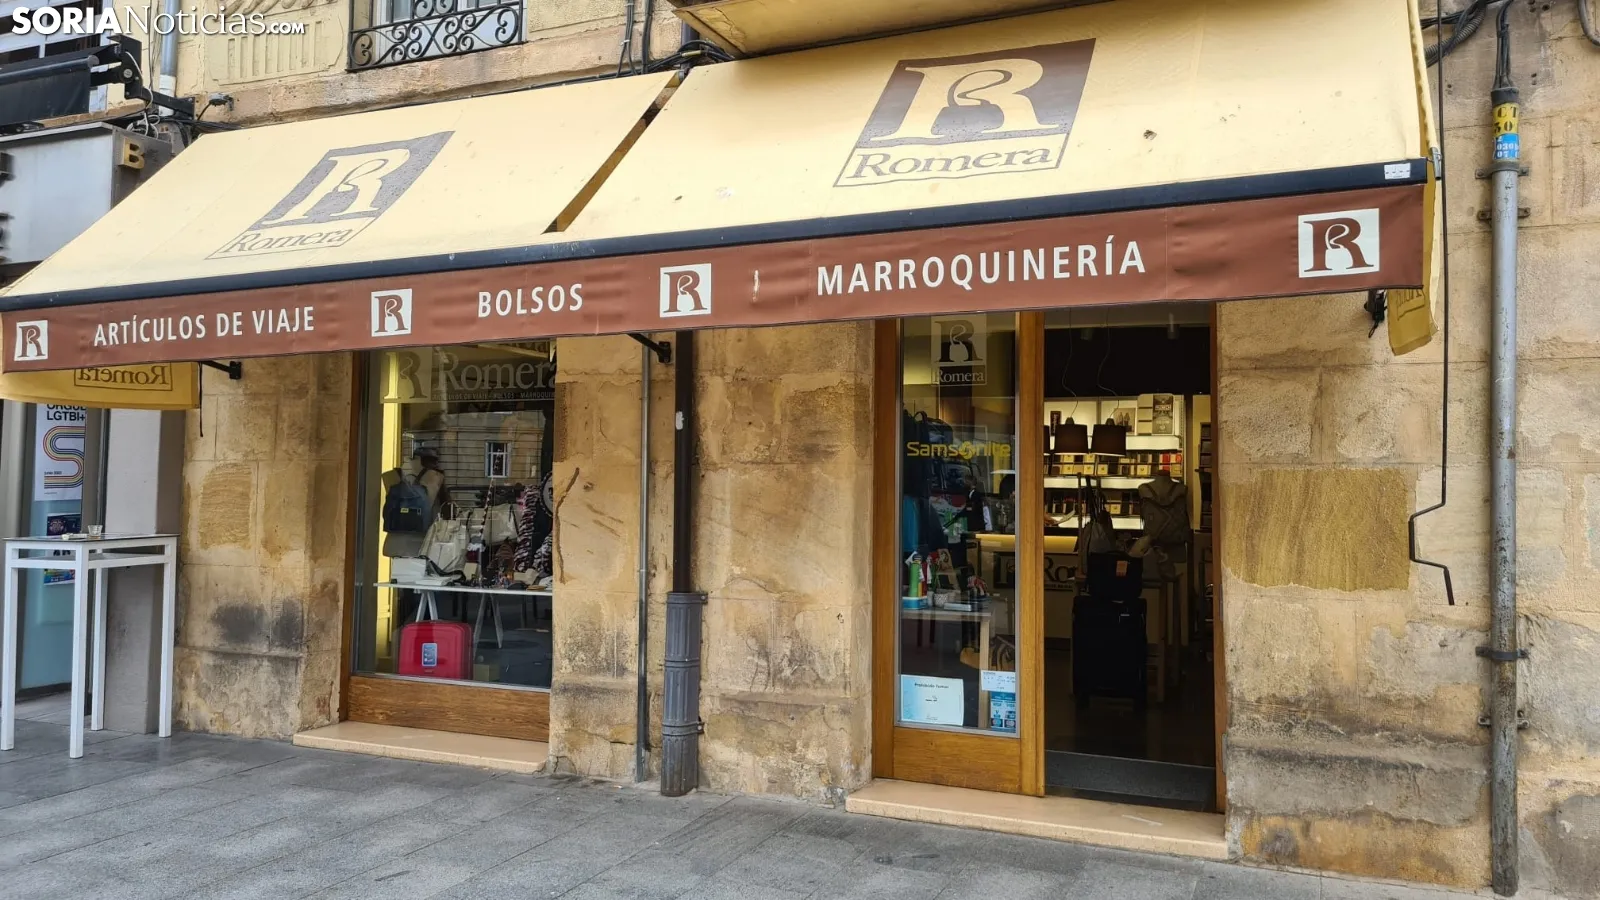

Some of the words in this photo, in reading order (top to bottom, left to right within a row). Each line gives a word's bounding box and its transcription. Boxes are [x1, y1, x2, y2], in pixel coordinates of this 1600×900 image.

[119, 137, 145, 169] B
[846, 147, 1053, 179] Romera
[220, 228, 353, 252] Romera
[817, 235, 1147, 296] MARROQUINERÍA
[478, 283, 583, 318] BOLSOS
[94, 314, 206, 347] ARTÍCULOS
[217, 313, 243, 337] DE
[252, 306, 315, 334] VIAJE
[933, 367, 985, 382] Romera
[46, 411, 86, 421] LGTBI+
[906, 440, 1011, 460] Samsonite
